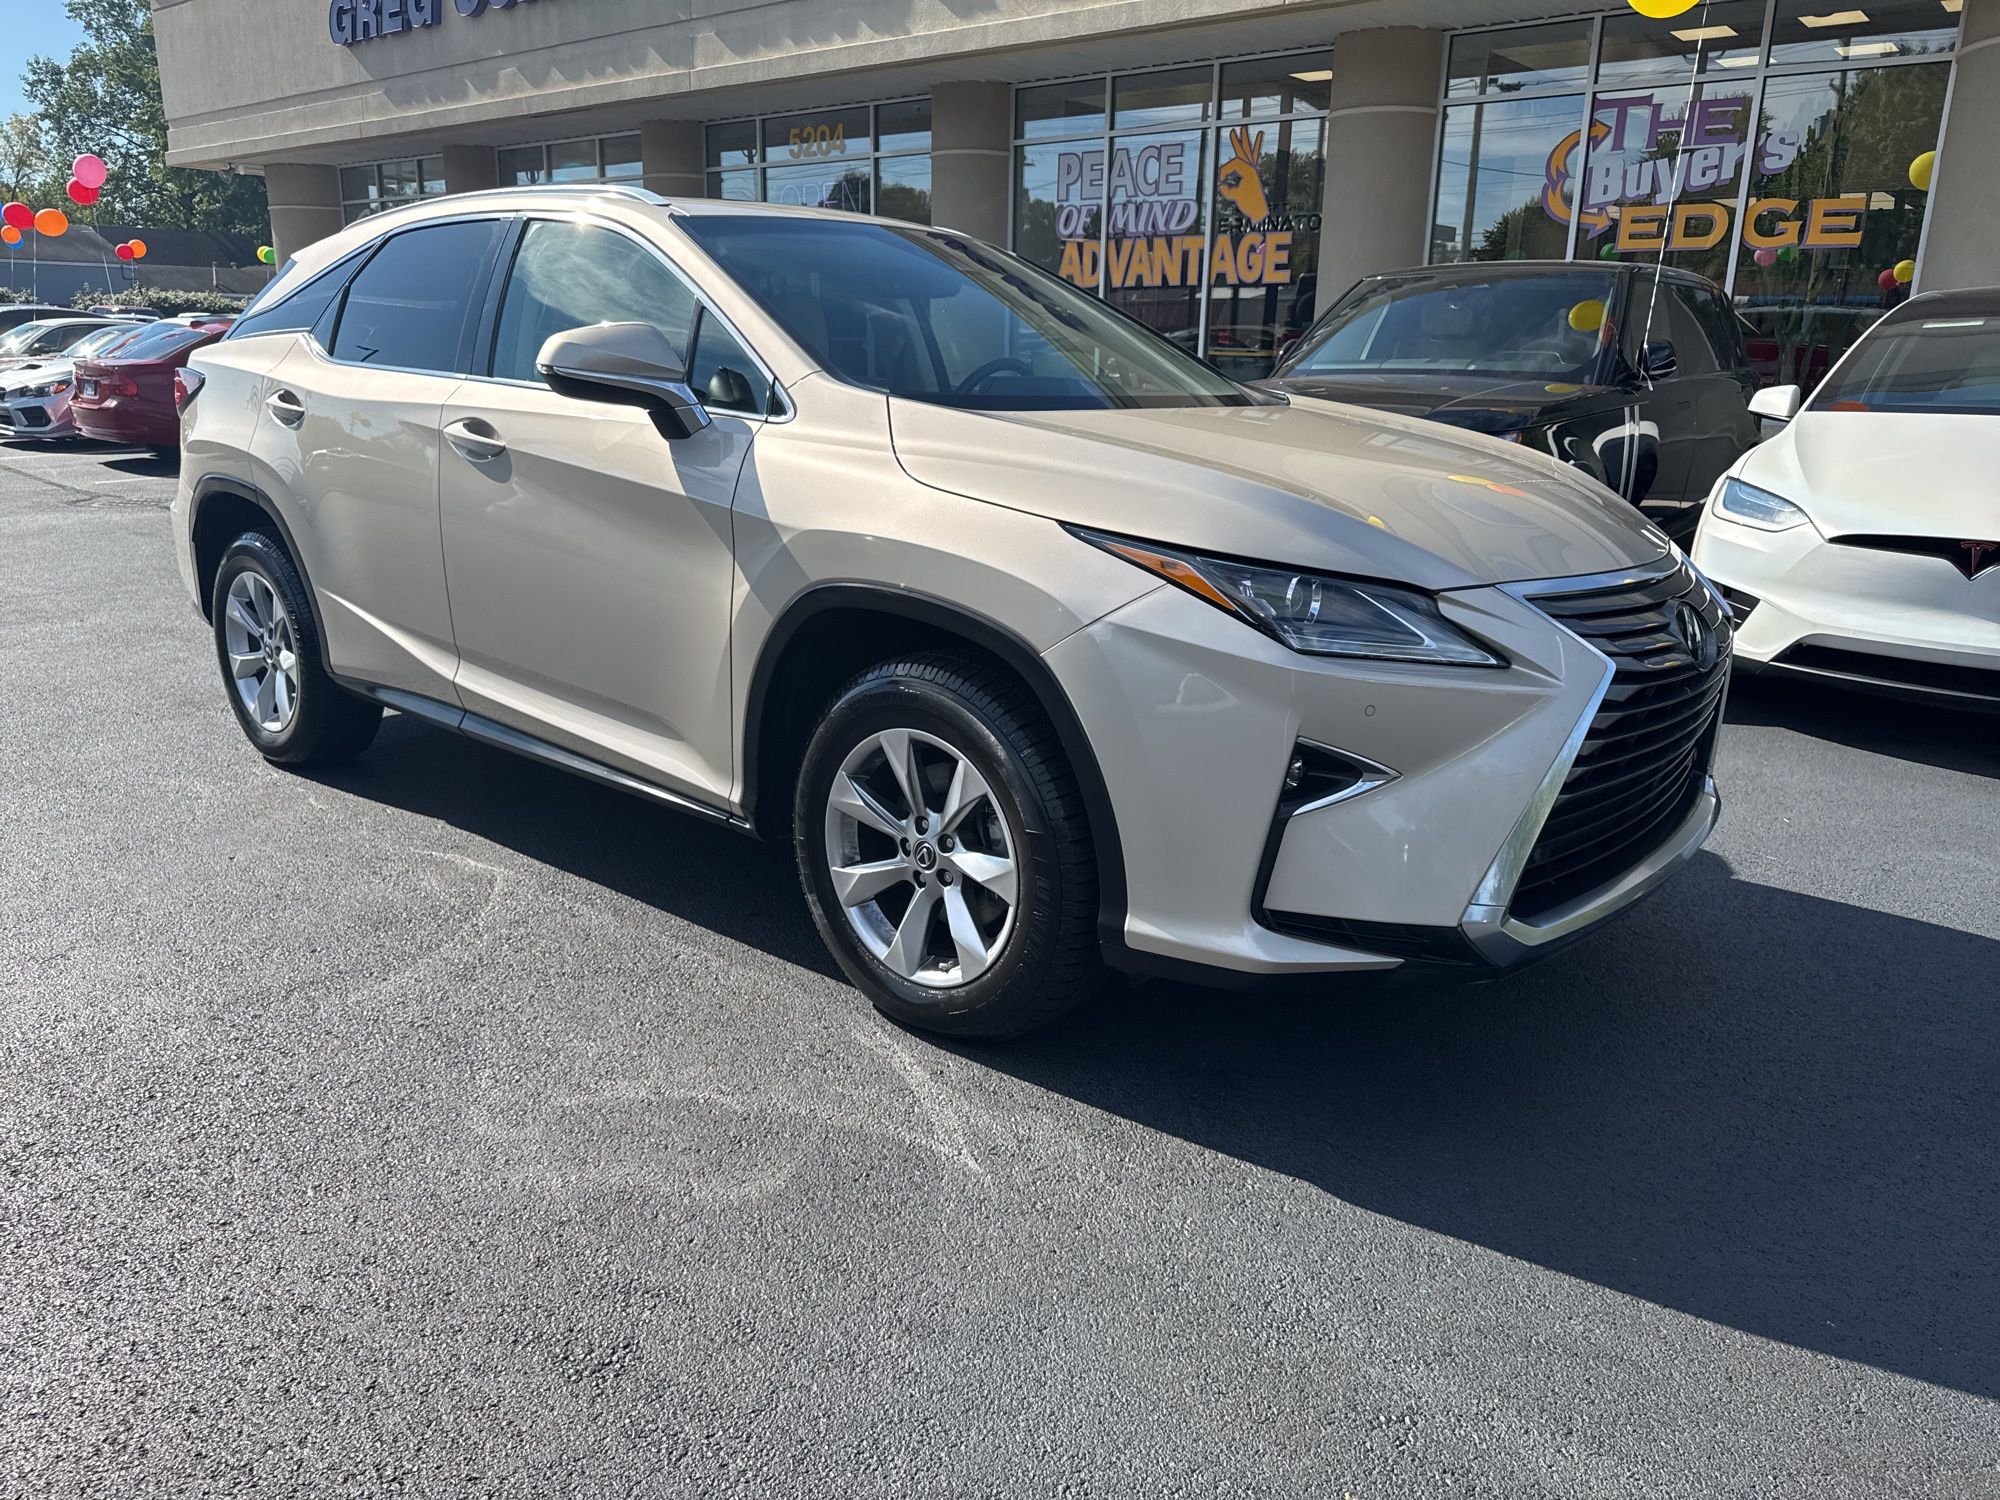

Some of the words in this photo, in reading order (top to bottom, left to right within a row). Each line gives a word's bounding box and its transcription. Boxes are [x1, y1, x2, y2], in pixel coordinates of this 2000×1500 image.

[788, 122, 847, 160] 5204
[1592, 92, 1747, 154] THE
[1057, 143, 1184, 201] PEACE
[1587, 131, 1799, 207] Buyer's
[1056, 203, 1100, 240] OF
[1107, 199, 1199, 237] MIND
[1615, 196, 1867, 250] EDGE
[1059, 231, 1292, 288] ADVANTAGE
